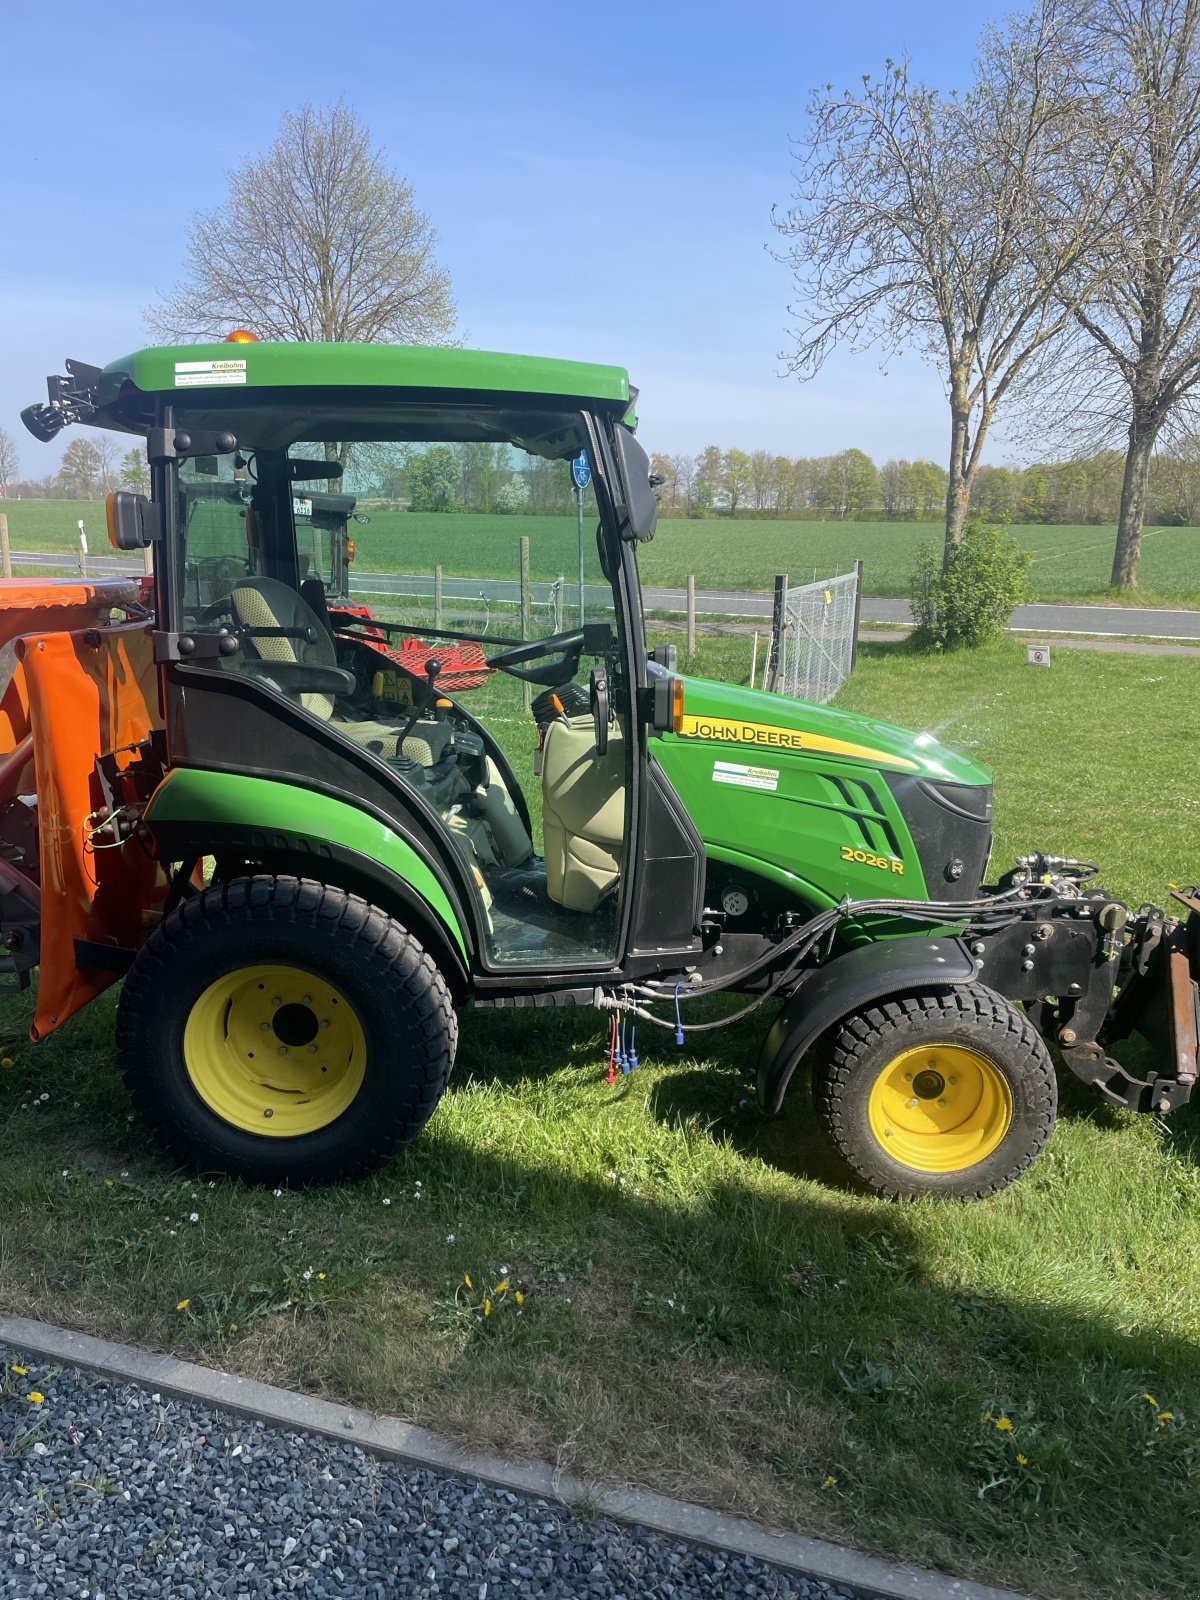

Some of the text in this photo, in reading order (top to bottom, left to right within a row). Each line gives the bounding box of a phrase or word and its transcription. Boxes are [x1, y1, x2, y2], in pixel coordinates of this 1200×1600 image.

[212, 362, 244, 370] Kreibohm
[689, 721, 802, 748] JOHN DEERE
[841, 846, 905, 876] 2026 R
